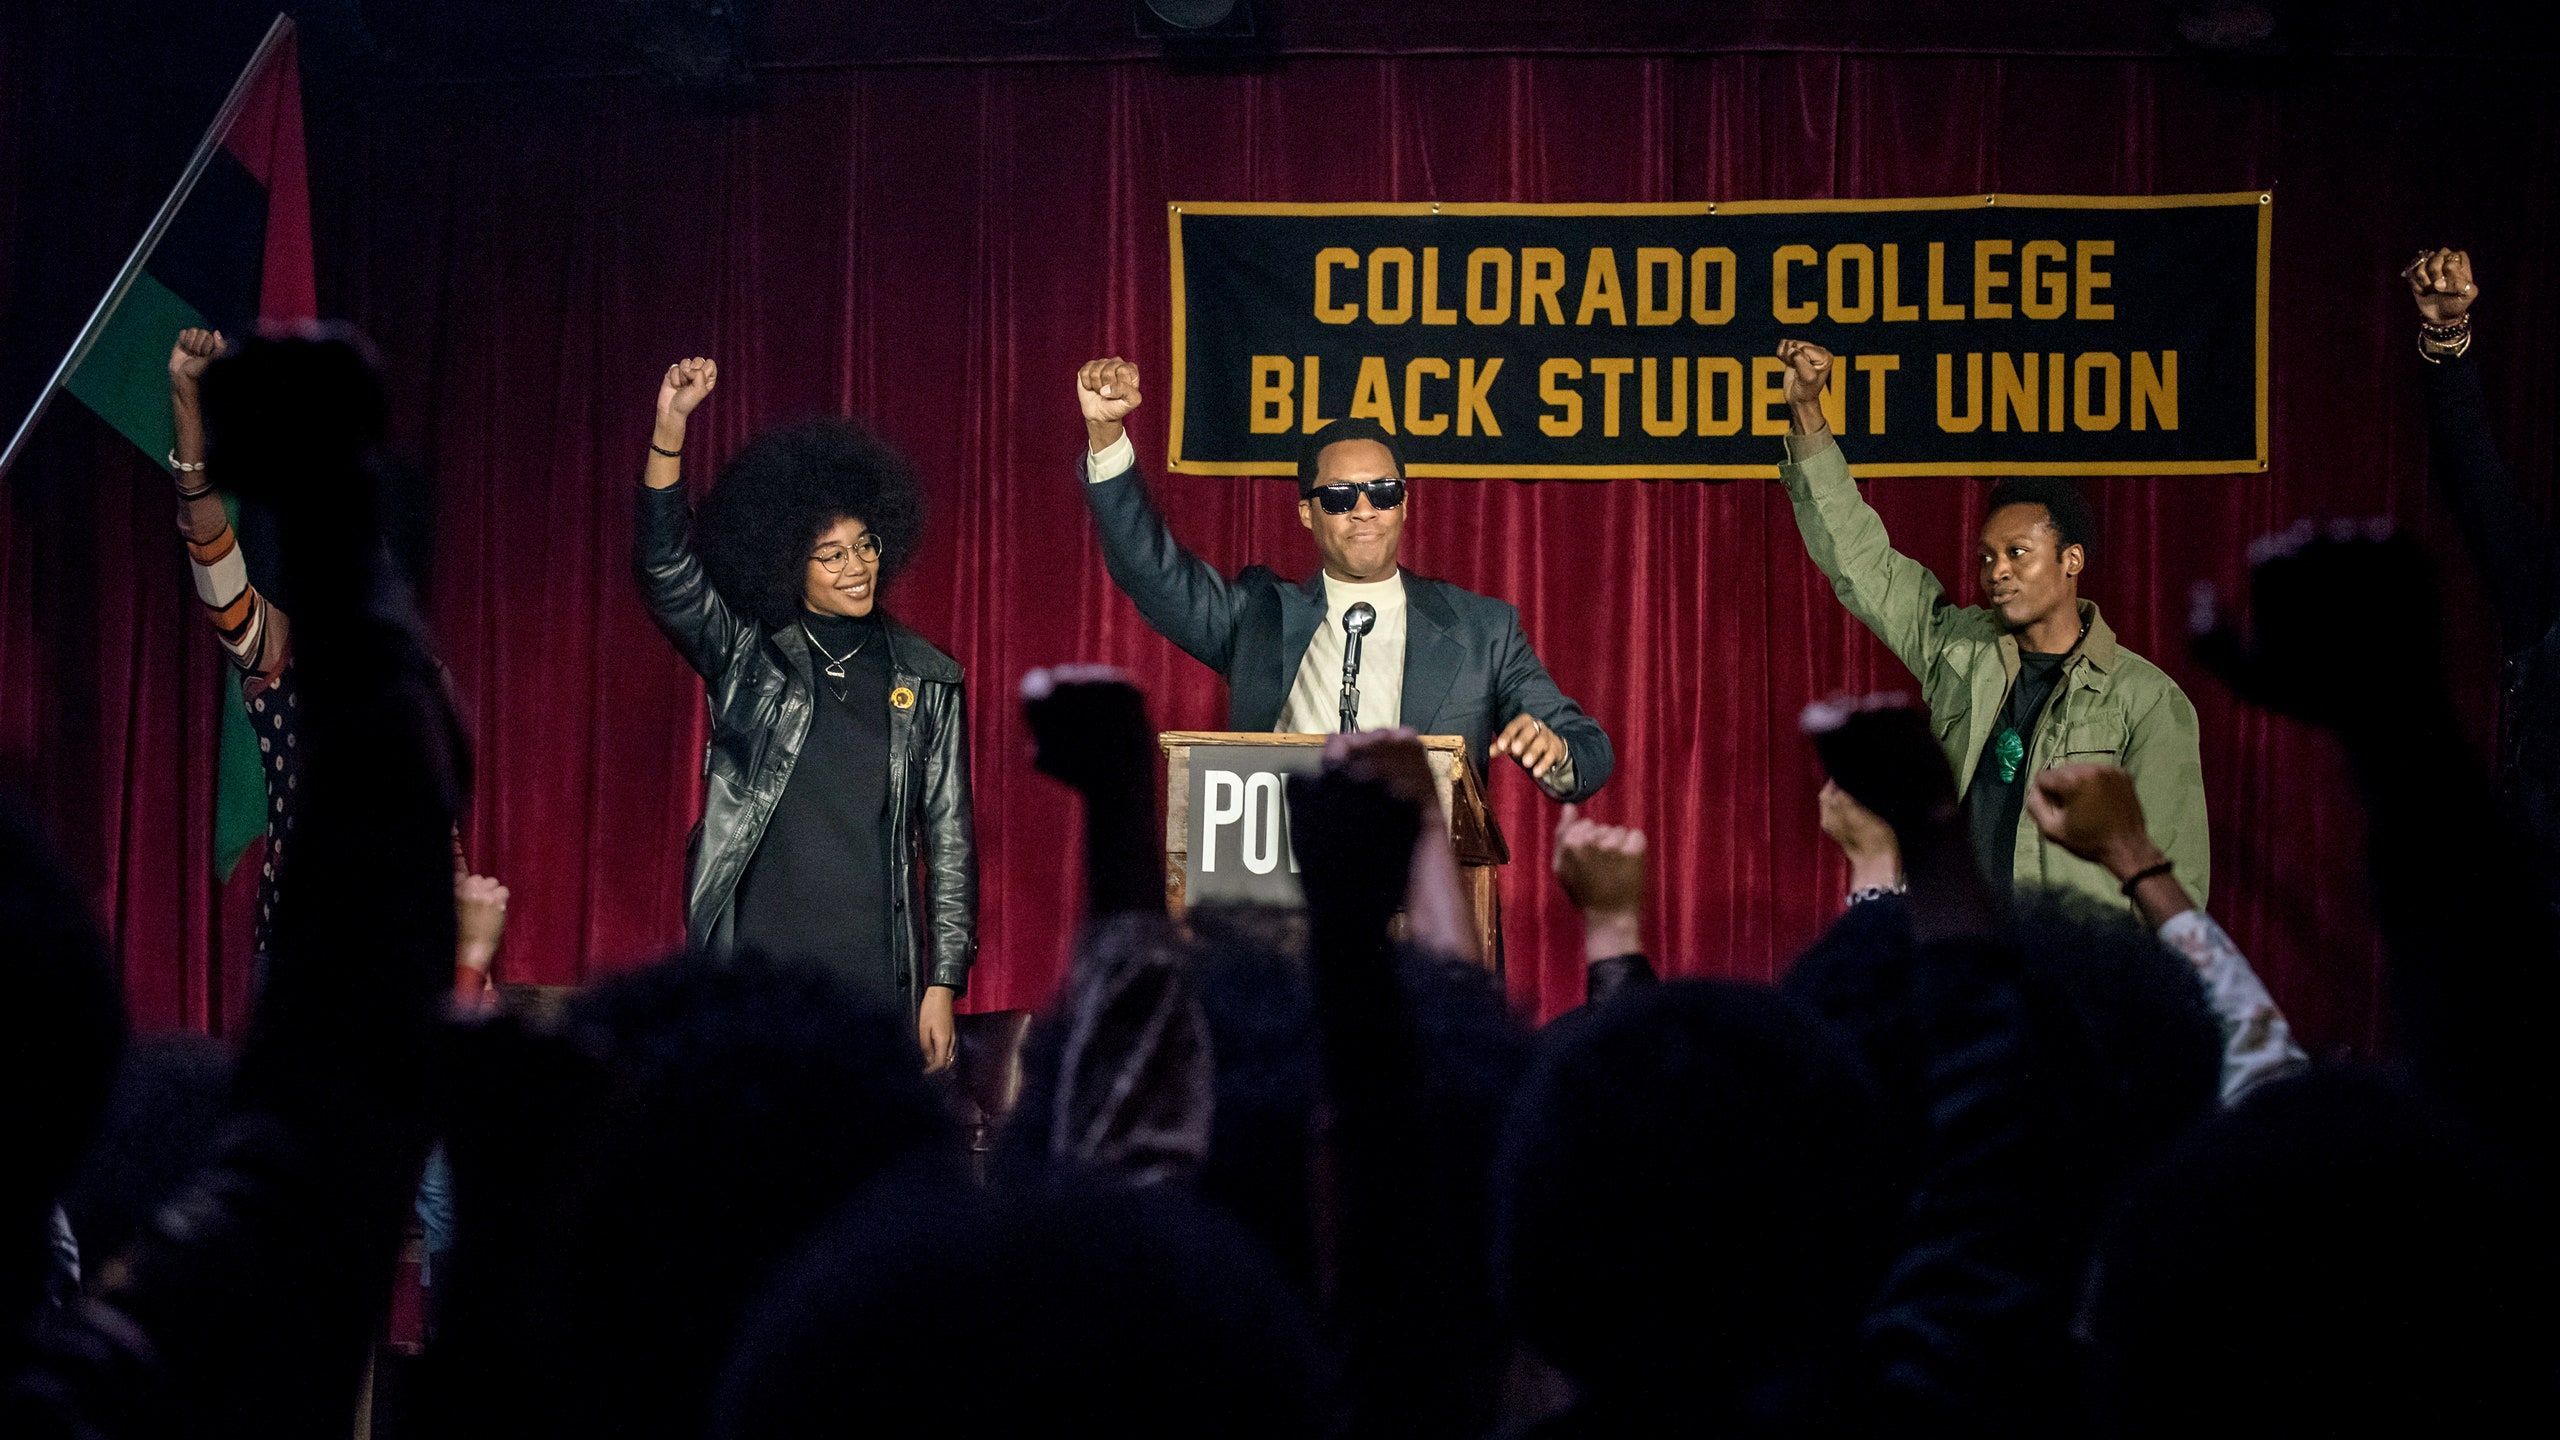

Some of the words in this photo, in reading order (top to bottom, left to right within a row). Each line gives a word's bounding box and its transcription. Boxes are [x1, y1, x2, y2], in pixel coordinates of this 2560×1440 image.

[1313, 246, 1737, 326] COLORADO
[1772, 239, 2115, 325] COLLEGE
[1249, 354, 1505, 437] BLACK
[1935, 349, 2179, 434] UNION
[1201, 769, 1301, 875] PO
